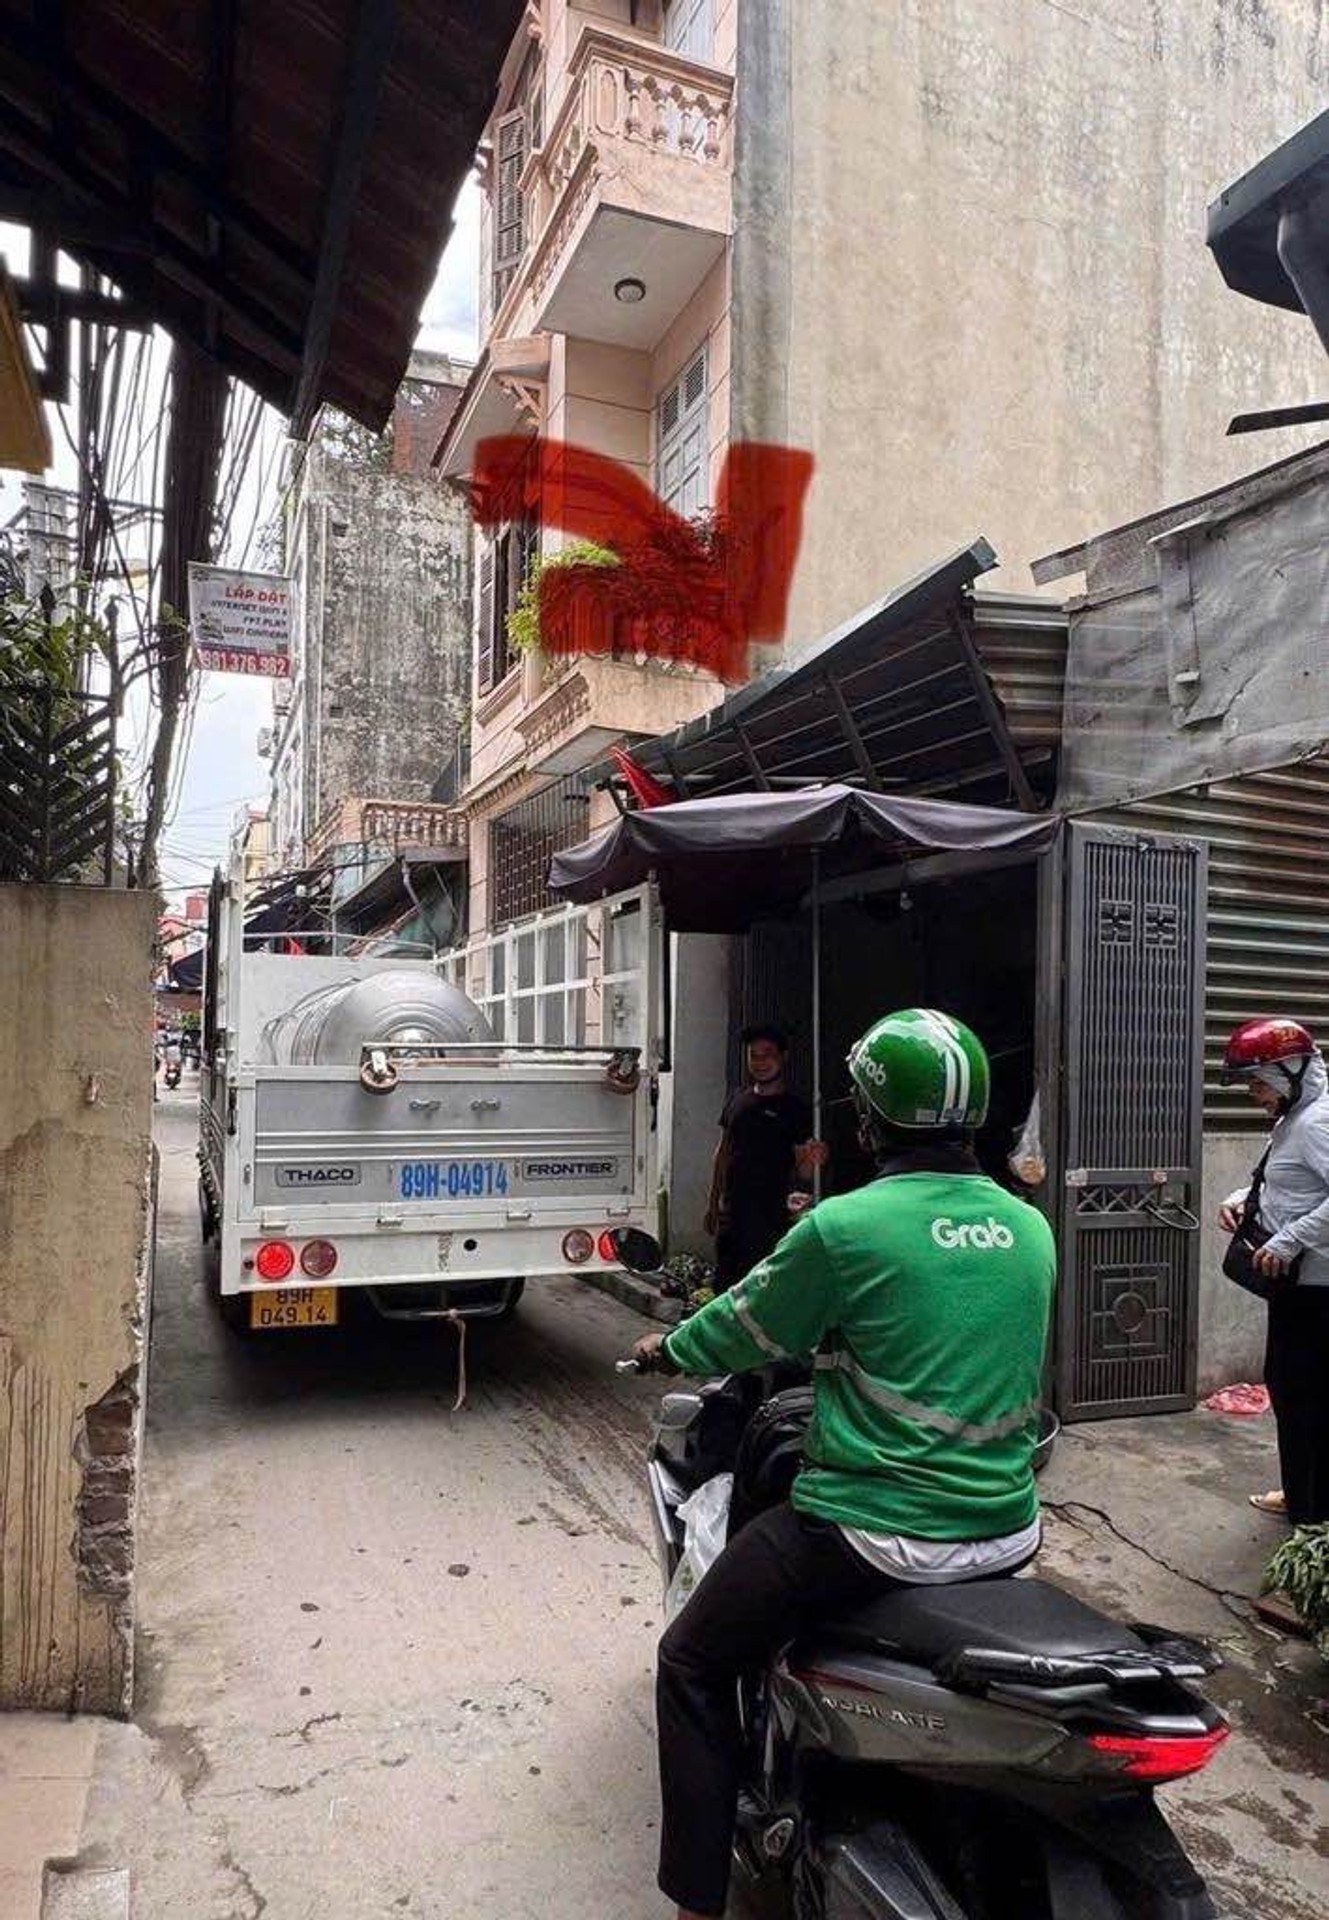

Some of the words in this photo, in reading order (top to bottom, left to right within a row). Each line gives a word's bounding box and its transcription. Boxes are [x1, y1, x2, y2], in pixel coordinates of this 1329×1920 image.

[284, 1167, 354, 1182] THACO
[526, 1161, 613, 1176] FRONTIER
[400, 1162, 508, 1198] 89H-04914
[931, 1216, 1014, 1249] Grab
[276, 1288, 313, 1304] 89H
[260, 1304, 327, 1325] 049.14
